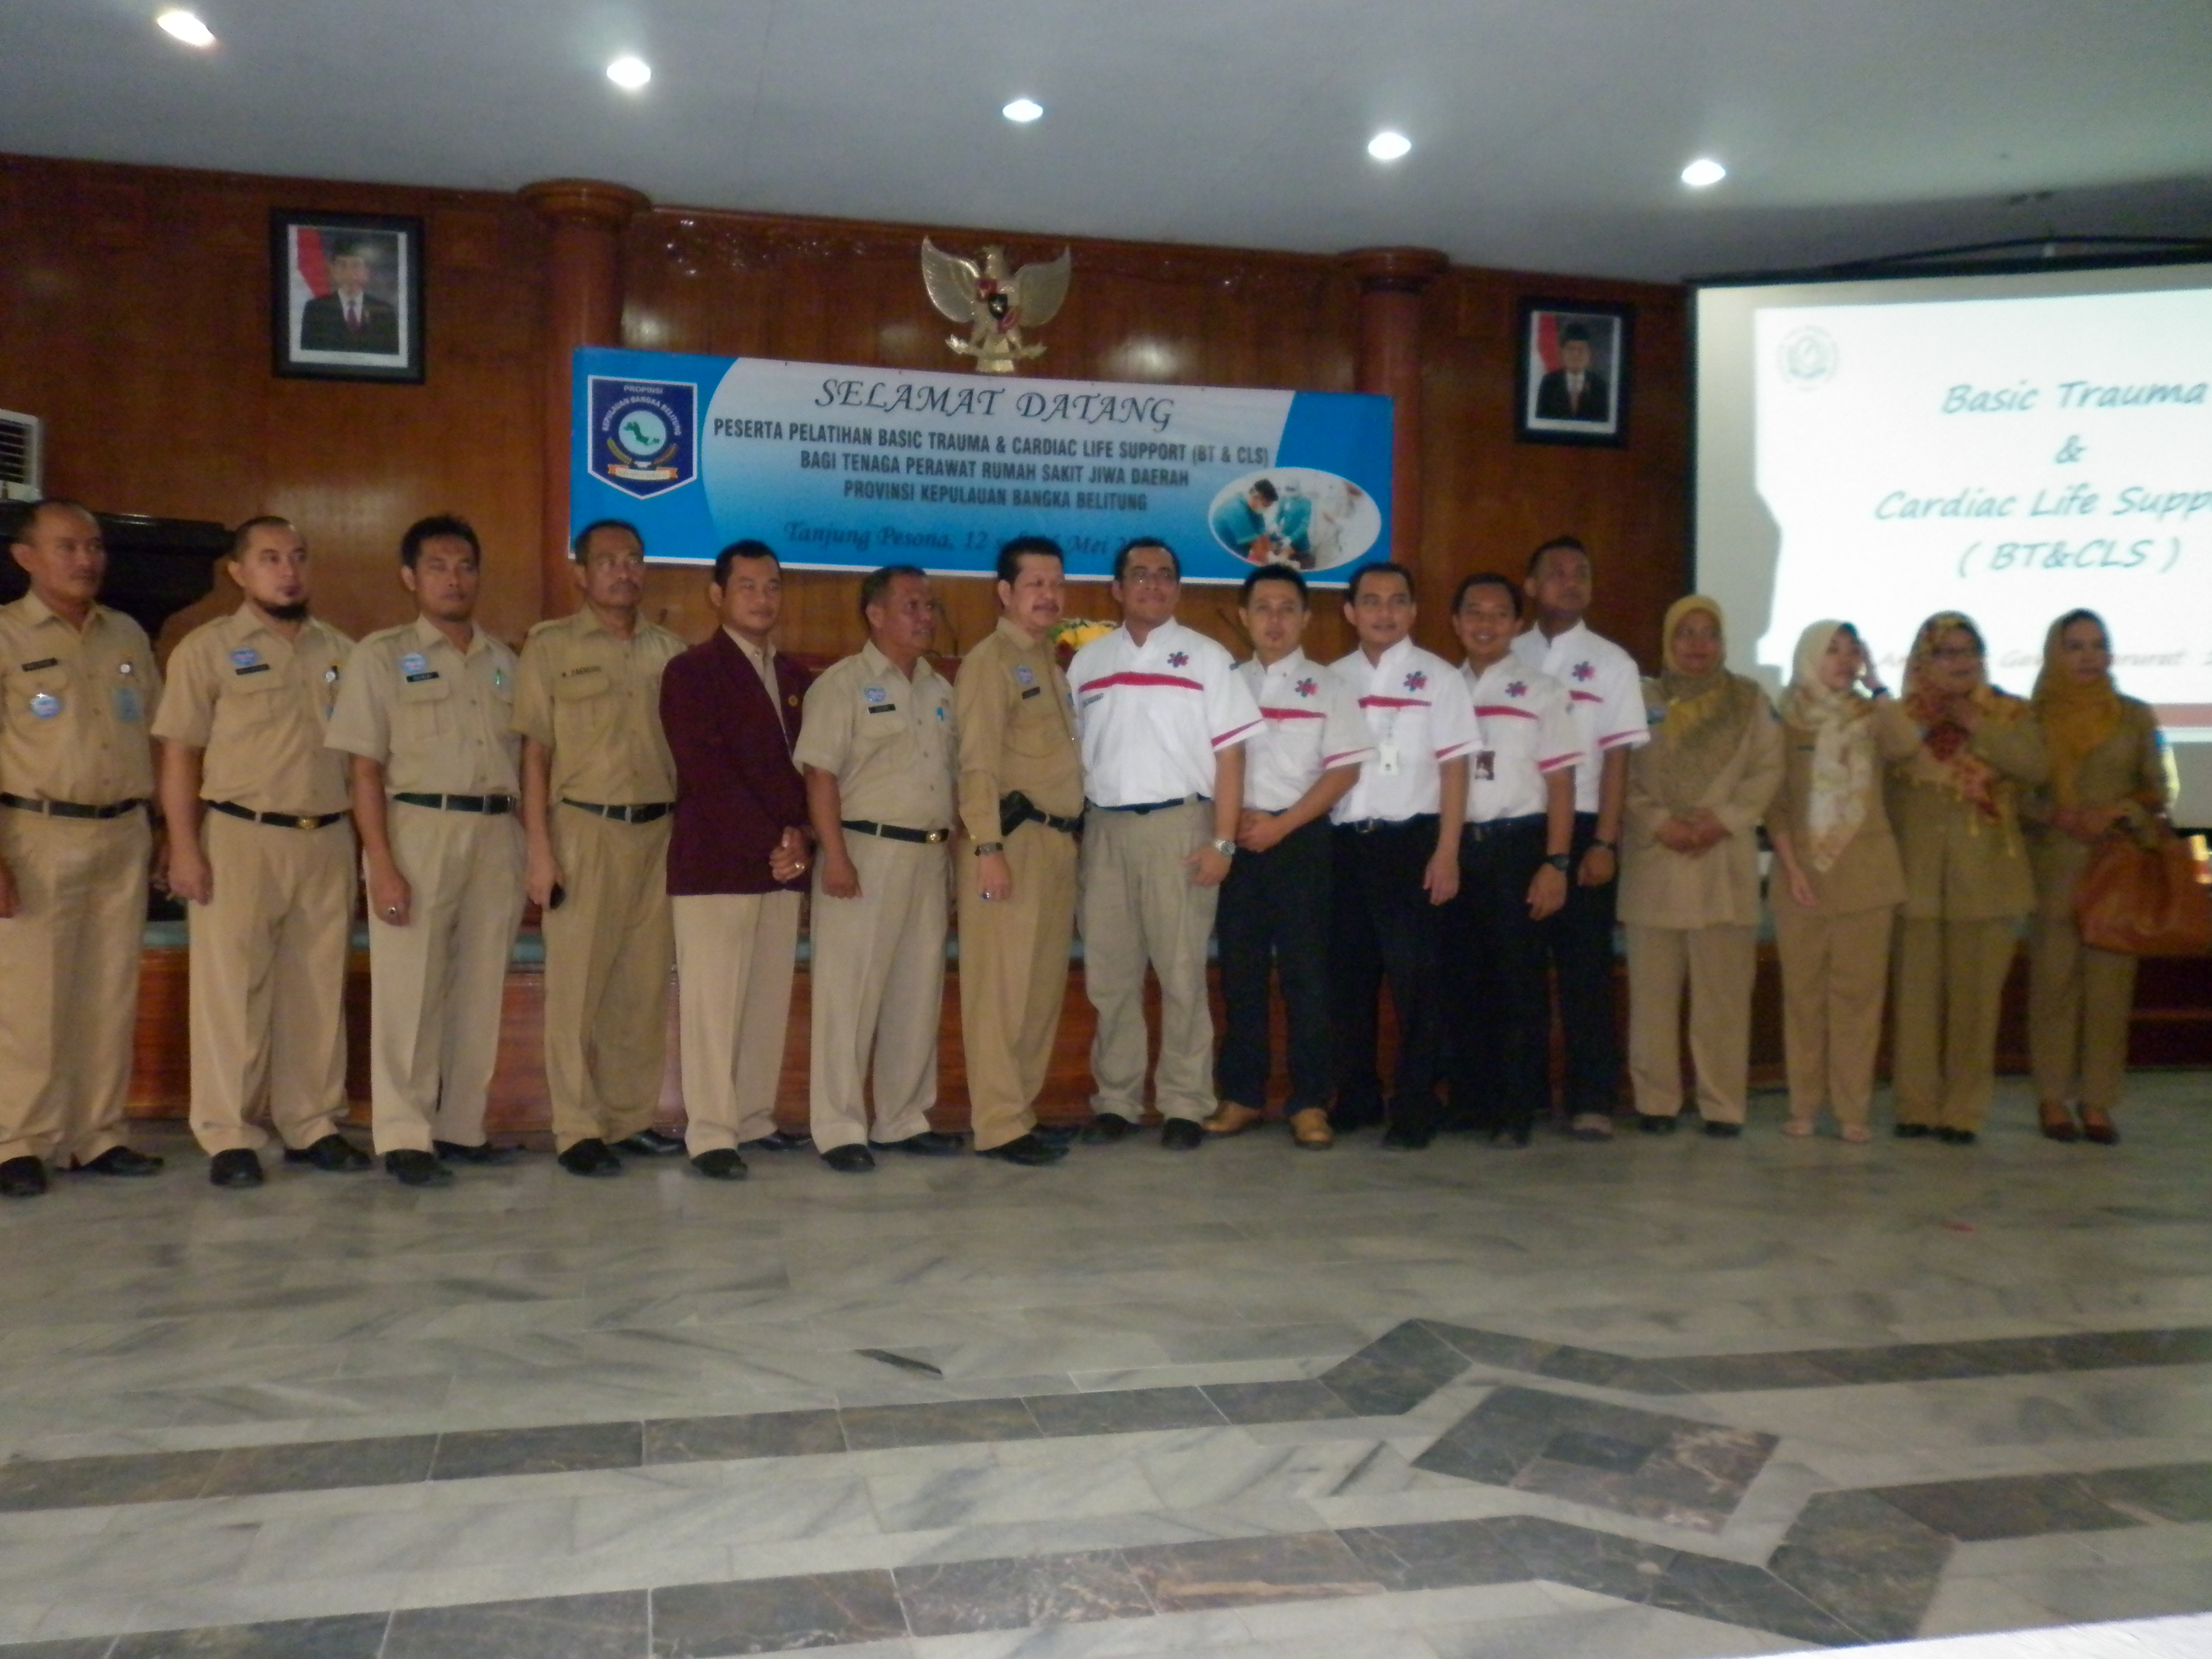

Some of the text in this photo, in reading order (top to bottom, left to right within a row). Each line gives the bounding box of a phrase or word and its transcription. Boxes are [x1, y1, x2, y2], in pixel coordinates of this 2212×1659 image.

[815, 379, 1174, 432] SELAMAT DATANG
[1942, 379, 2208, 414] Basic Trauma
[714, 418, 1269, 468] PESERTA PELATIHAN BASIC TRAUMA & CARDIAC LIFE SUPPORT (BT & CLS)
[2055, 435, 2086, 463] &
[801, 450, 1188, 486] BAGI TENAGA PERAWAT RUMAH SAKIT JIWA DAERAH
[844, 479, 1147, 510] PROVINSI KEPULAUAN BANGKA BELITUNG
[1875, 488, 2017, 520] Cardiac
[2030, 482, 2100, 517] Life
[784, 521, 871, 551] Tanjung
[1991, 539, 2153, 570] BT&CLS
